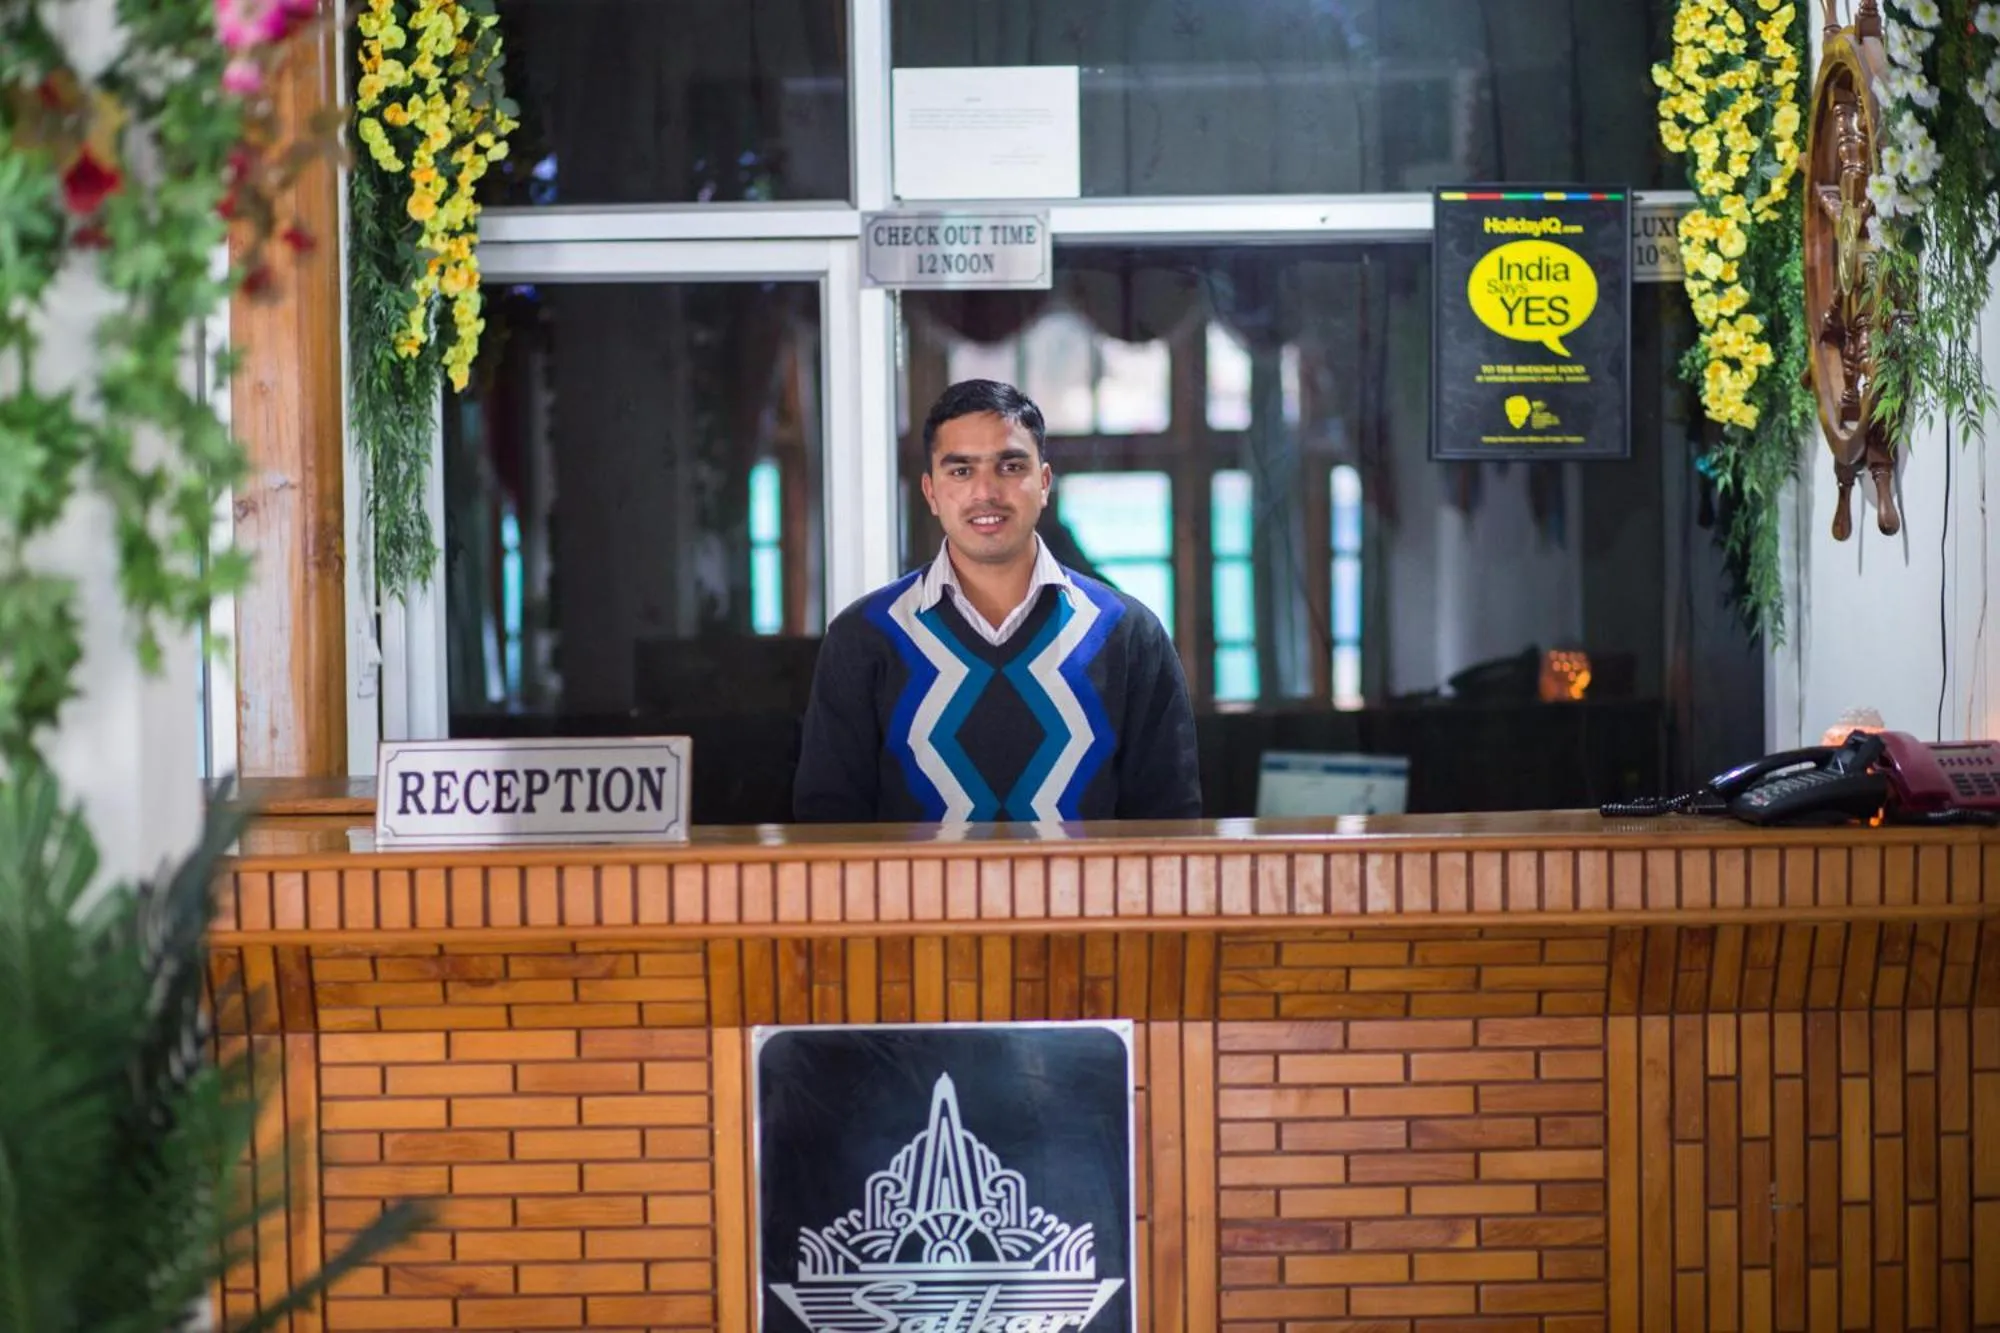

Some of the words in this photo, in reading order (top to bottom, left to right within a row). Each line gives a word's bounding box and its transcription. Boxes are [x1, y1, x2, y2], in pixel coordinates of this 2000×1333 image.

[874, 225, 940, 247] CHECK
[944, 226, 982, 246] OUT
[990, 225, 1036, 245] TIME
[917, 254, 937, 274] 12
[941, 254, 995, 274] NOON
[1637, 245, 1678, 265] 10%
[1498, 256, 1570, 282] India
[1500, 296, 1570, 327] YES
[397, 766, 666, 815] RECEPTION
